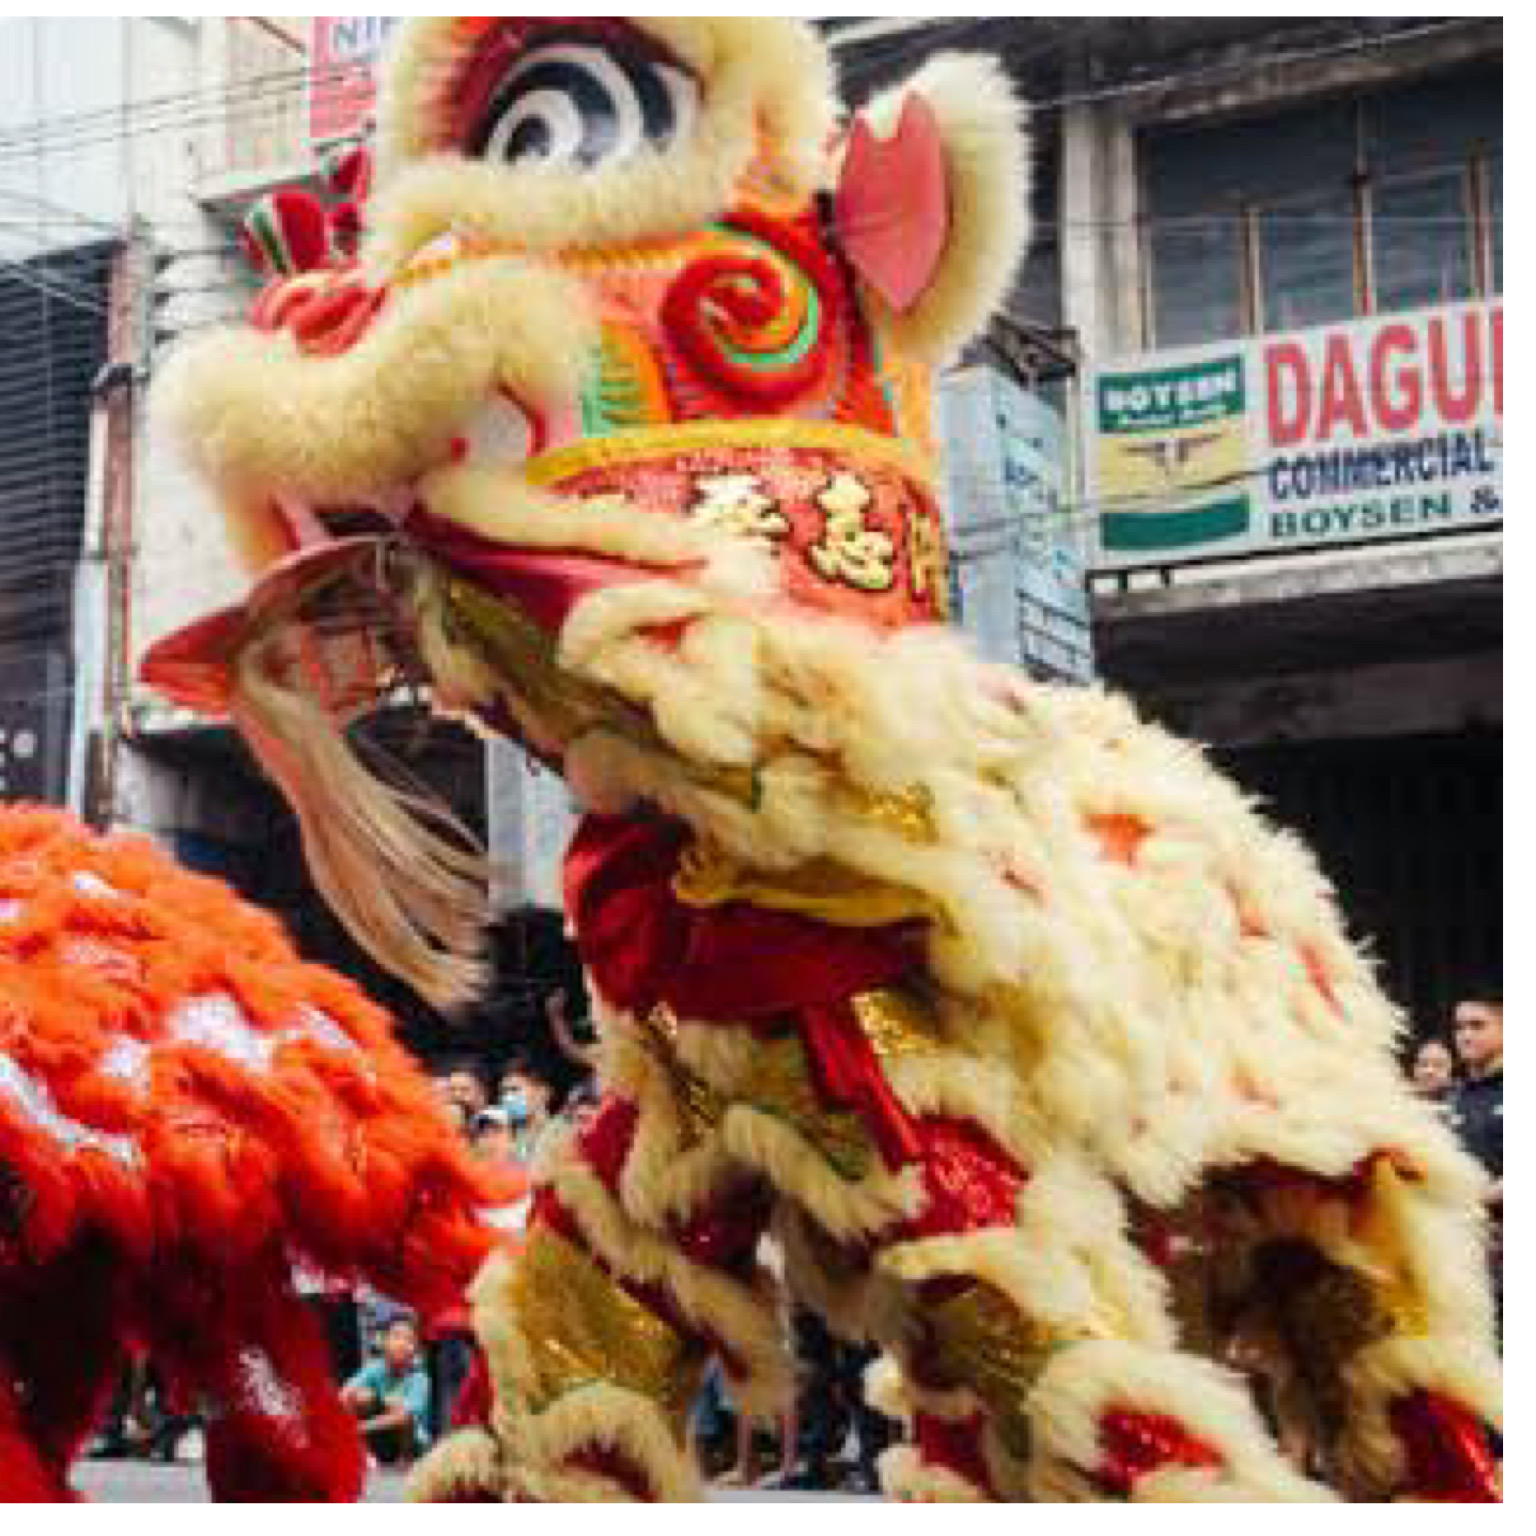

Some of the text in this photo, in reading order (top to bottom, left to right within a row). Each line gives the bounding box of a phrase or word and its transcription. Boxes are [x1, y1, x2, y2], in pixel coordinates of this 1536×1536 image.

[1104, 367, 1238, 414] BOYSEN
[1271, 427, 1495, 501] COMMERCIAL
[1271, 492, 1454, 539] BOYSEN
